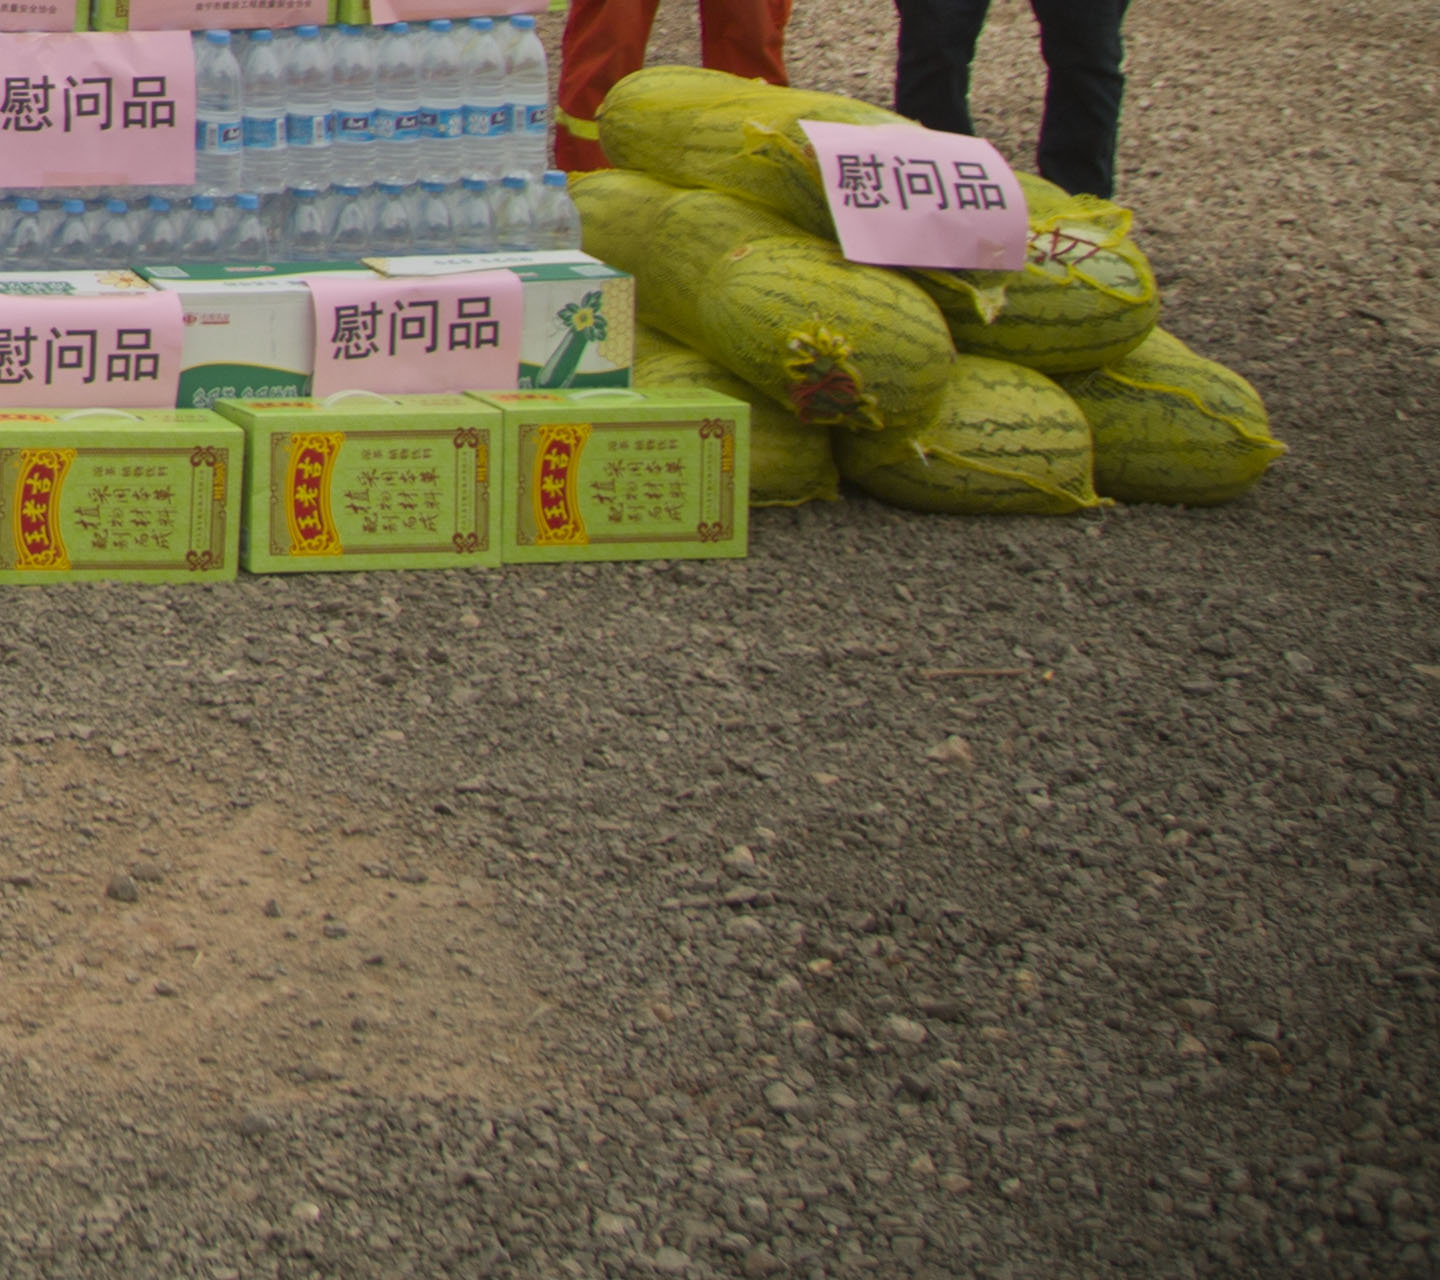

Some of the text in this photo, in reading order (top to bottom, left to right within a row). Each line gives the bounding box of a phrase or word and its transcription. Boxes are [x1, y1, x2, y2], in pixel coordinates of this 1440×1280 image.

[195, 0, 312, 12] 南宁市建设工程质量安全协会
[0, 76, 174, 132] 慰问品
[837, 155, 1006, 210] 慰问品
[332, 297, 499, 359] 慰问品
[26, 473, 53, 552] 王老吉
[295, 448, 323, 535] 王老吉
[544, 451, 572, 532] 王老吉
